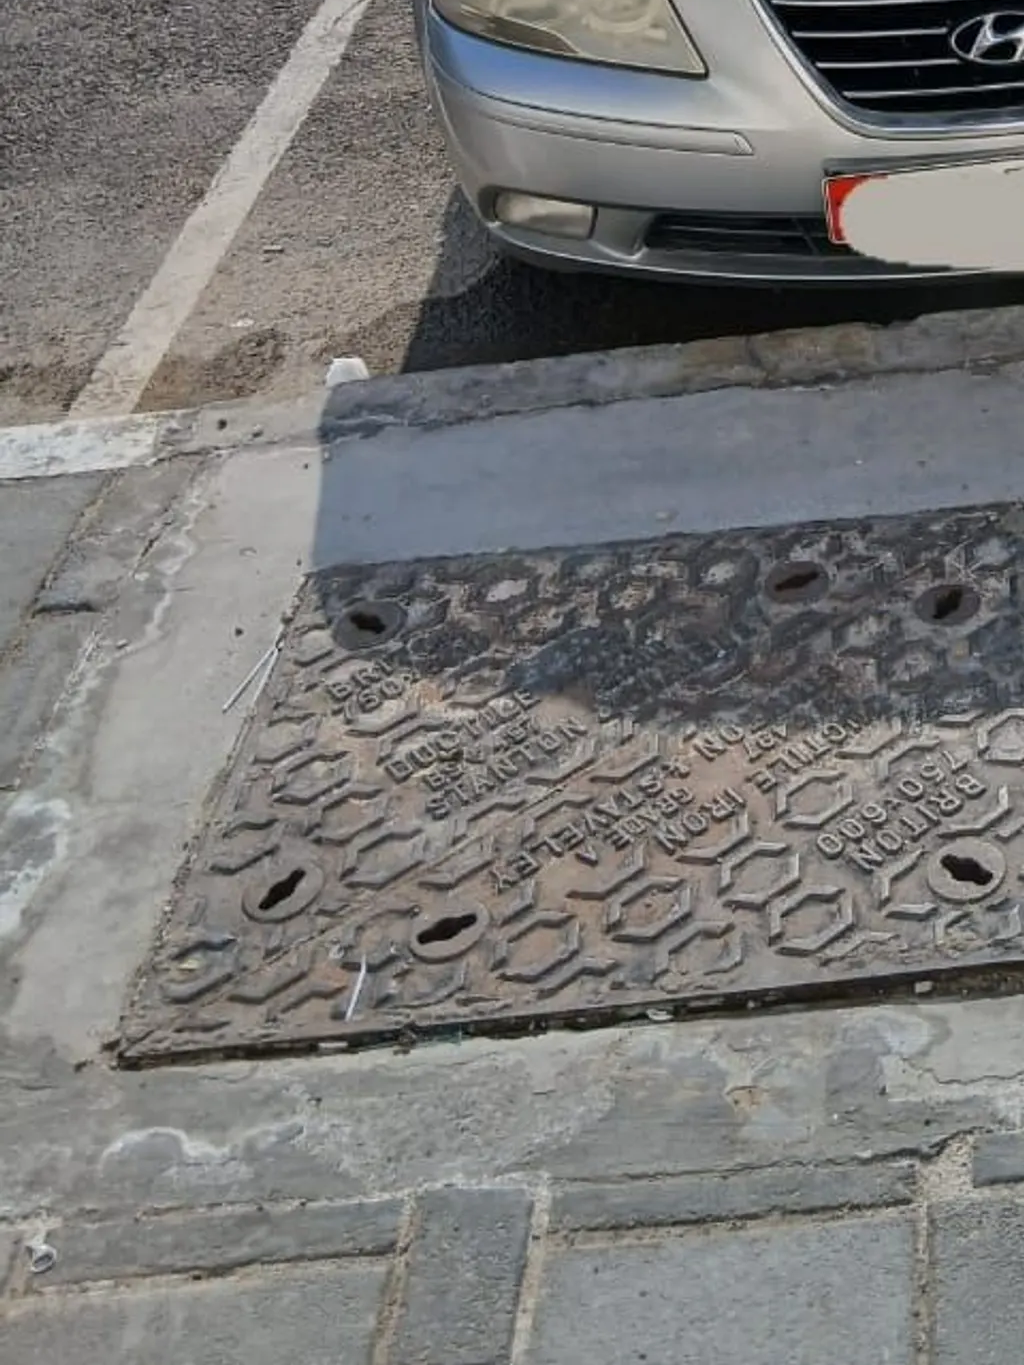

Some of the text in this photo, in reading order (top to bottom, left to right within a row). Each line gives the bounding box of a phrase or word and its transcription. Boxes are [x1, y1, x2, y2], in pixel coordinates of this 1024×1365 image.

[425, 716, 588, 821] STANTON
[489, 767, 665, 888] STAVELEY
[575, 844, 598, 866] A
[605, 786, 695, 851] GRADE
[656, 785, 746, 856] IRON
[850, 772, 987, 873] BRITON
